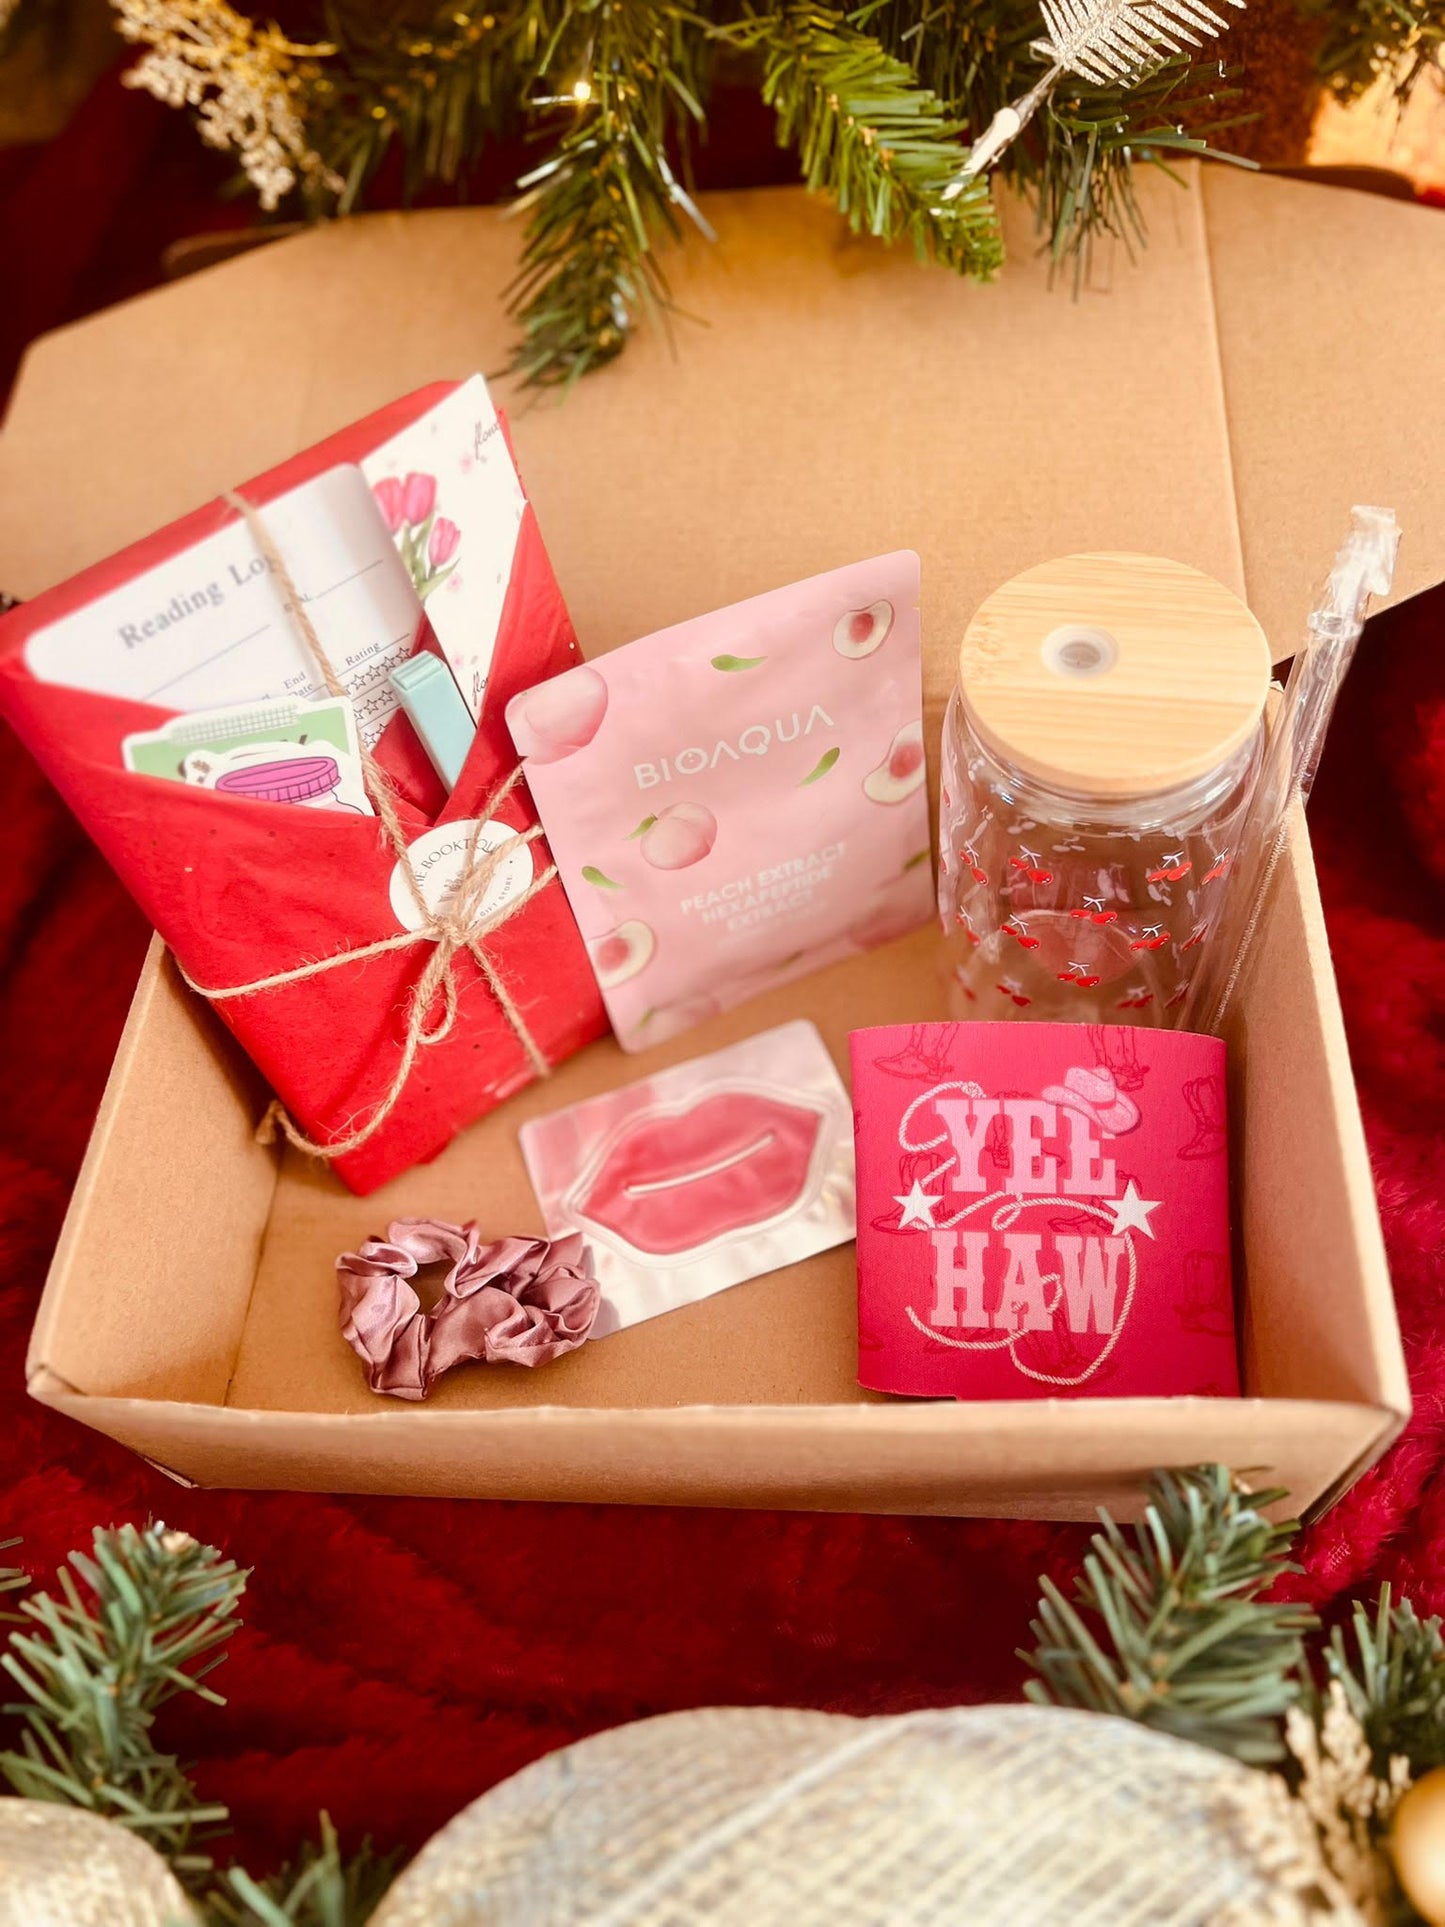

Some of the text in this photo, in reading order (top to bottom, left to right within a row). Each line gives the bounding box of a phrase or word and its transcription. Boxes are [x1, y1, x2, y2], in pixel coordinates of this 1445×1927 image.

[117, 581, 225, 649] Reading
[283, 671, 307, 690] End
[345, 641, 381, 667] Rating
[632, 704, 836, 790] BIOAQUA
[679, 841, 848, 916] PEACH EXTRACT
[935, 1098, 1117, 1196] YEE
[930, 1229, 1129, 1334] HAW
